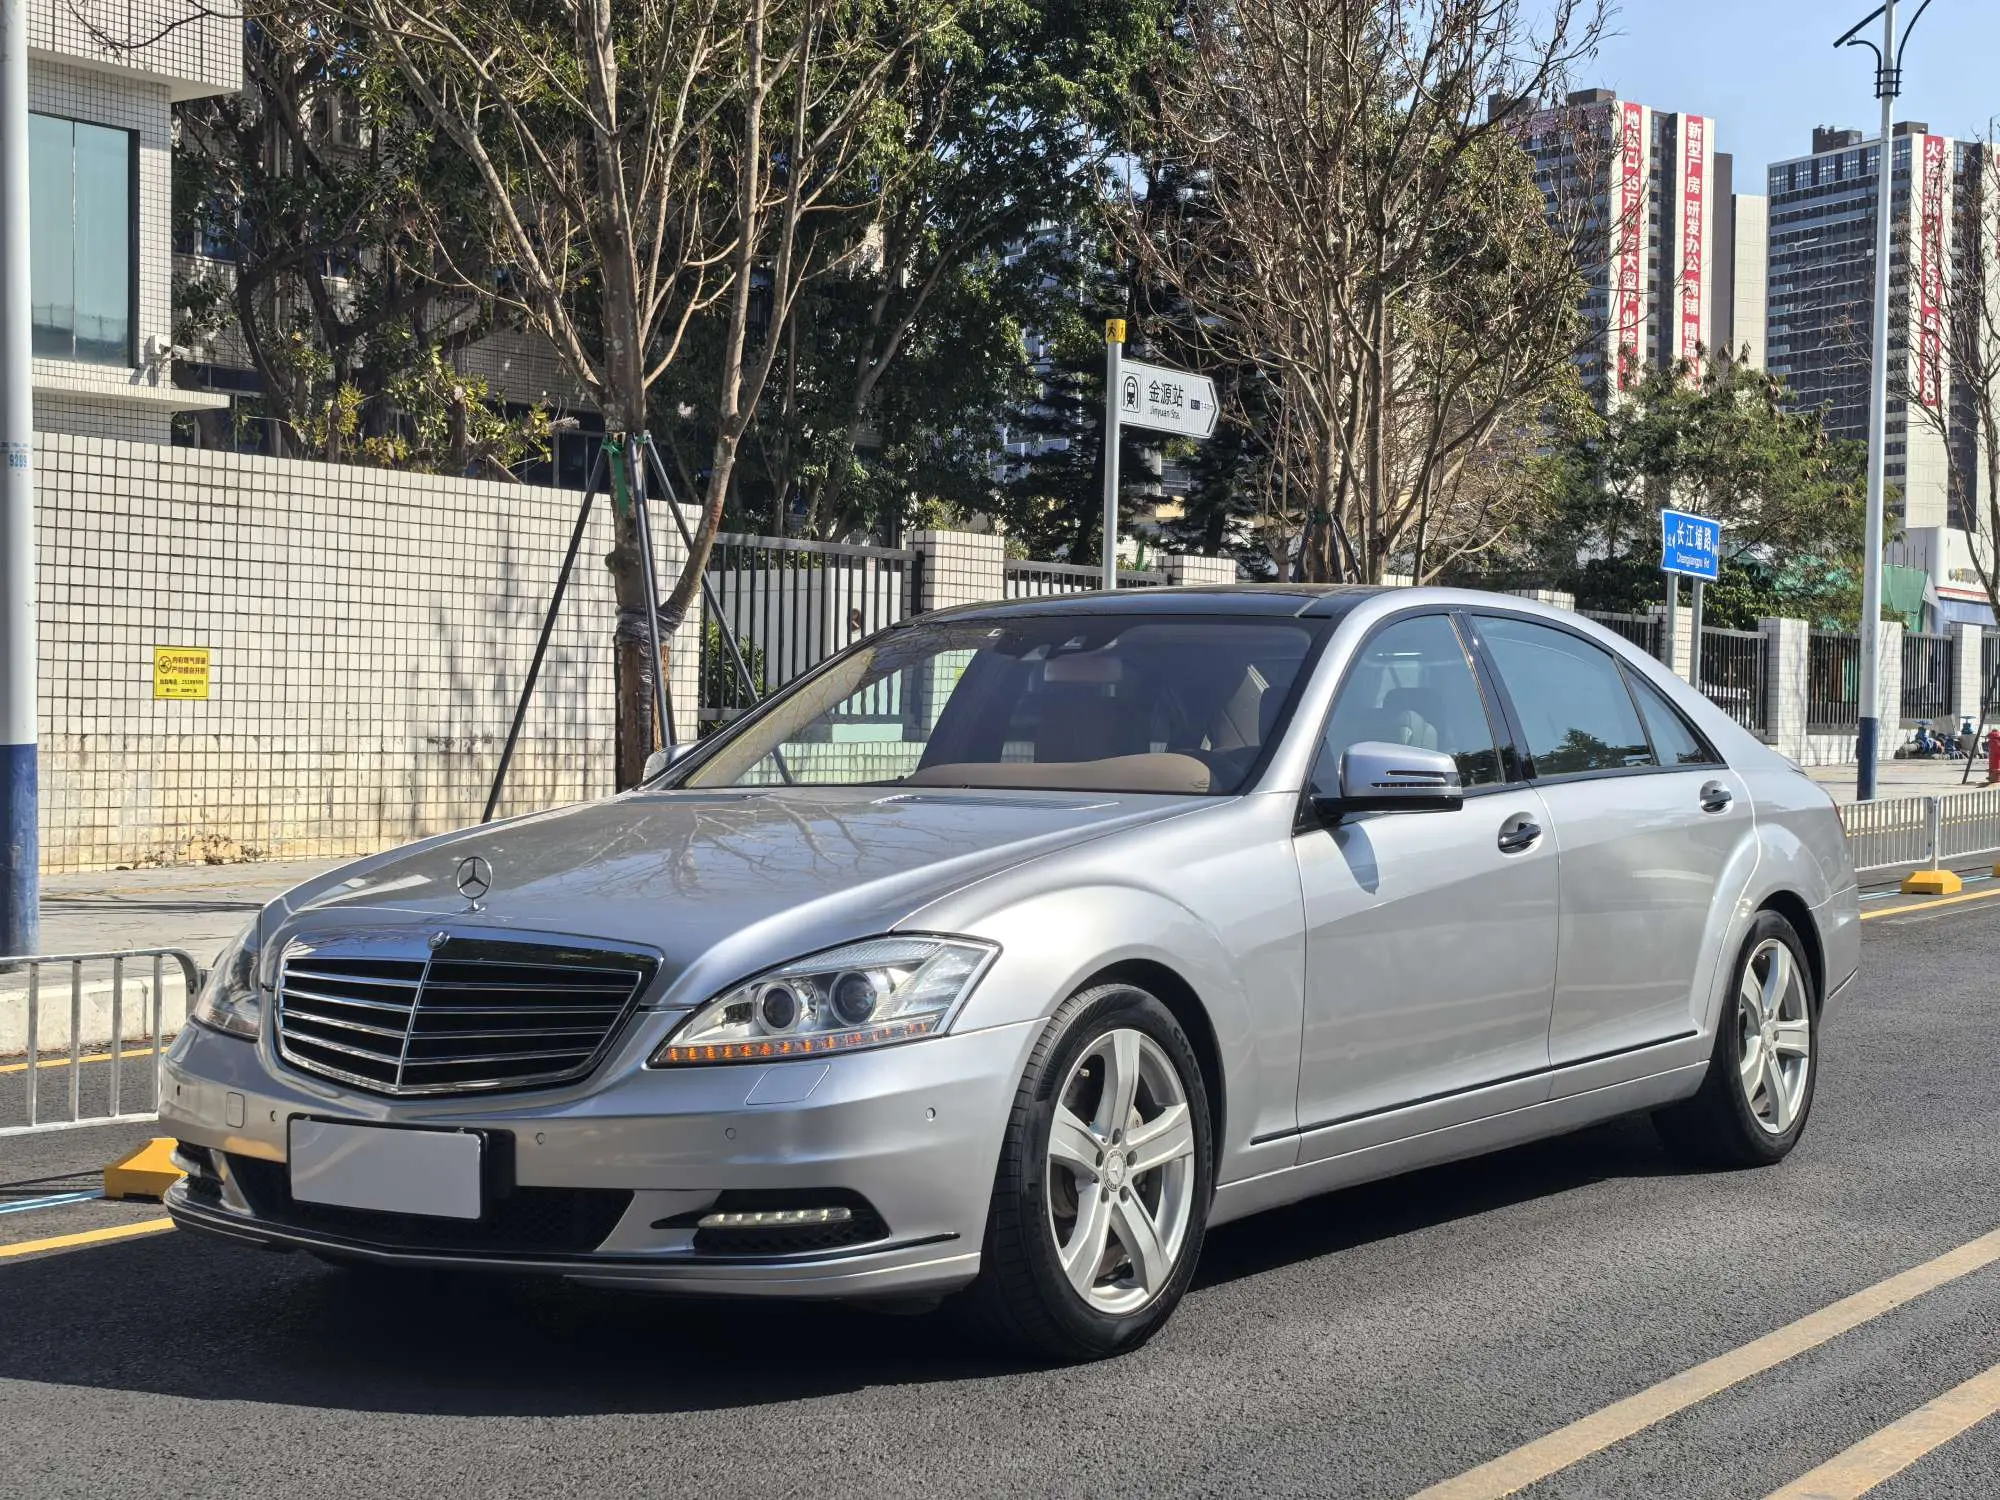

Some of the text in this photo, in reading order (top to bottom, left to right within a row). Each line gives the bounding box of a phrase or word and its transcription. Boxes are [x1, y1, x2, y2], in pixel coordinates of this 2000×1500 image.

[1625, 110, 1640, 168] 地铁口
[1687, 121, 1702, 195] 新型厂房
[1685, 200, 1701, 272] 研发办公
[1684, 279, 1699, 316] 商铺
[1149, 380, 1184, 408] 金源站
[1150, 405, 1170, 420] Jinyuan
[1677, 520, 1711, 552] 长江埔路
